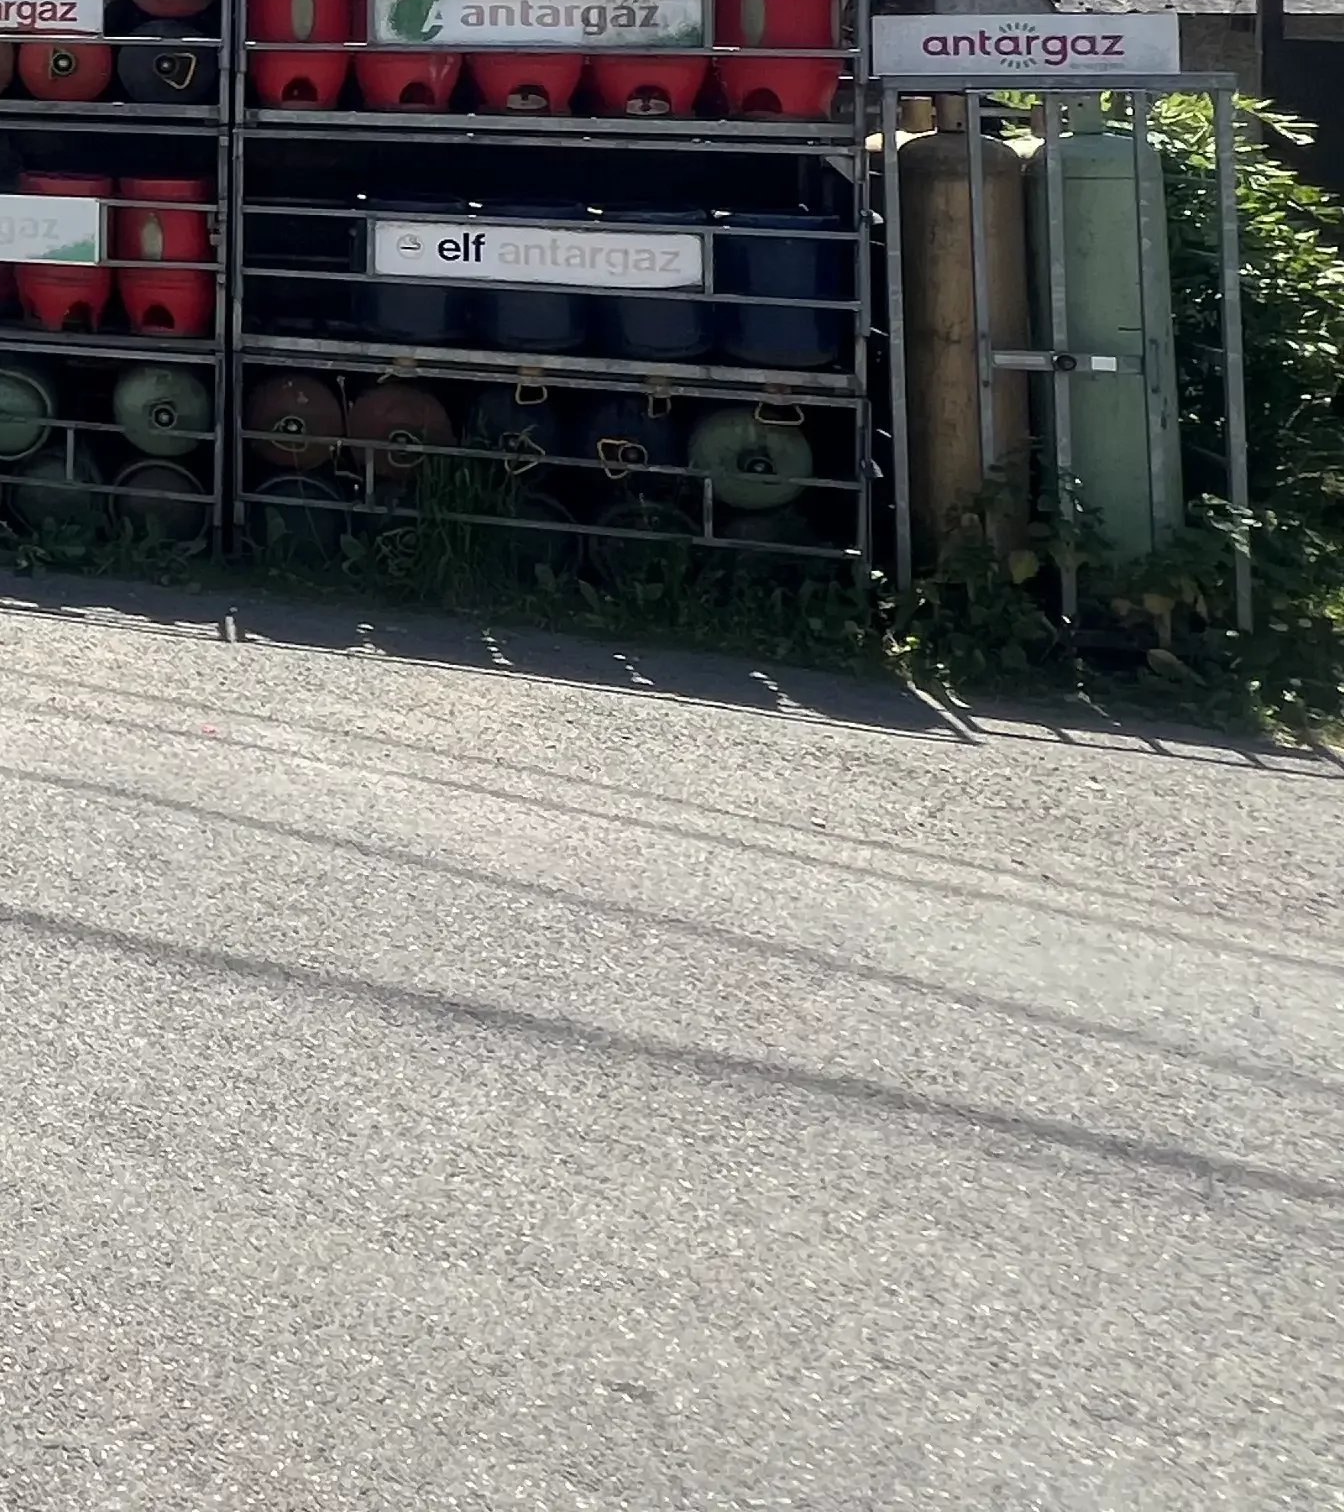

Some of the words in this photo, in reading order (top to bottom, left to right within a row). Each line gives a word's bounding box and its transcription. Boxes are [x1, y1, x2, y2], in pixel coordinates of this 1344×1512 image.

[460, 0, 660, 36] antargaz
[922, 30, 1125, 66] antargaz
[437, 232, 486, 263] elf
[497, 237, 682, 276] antargaz
